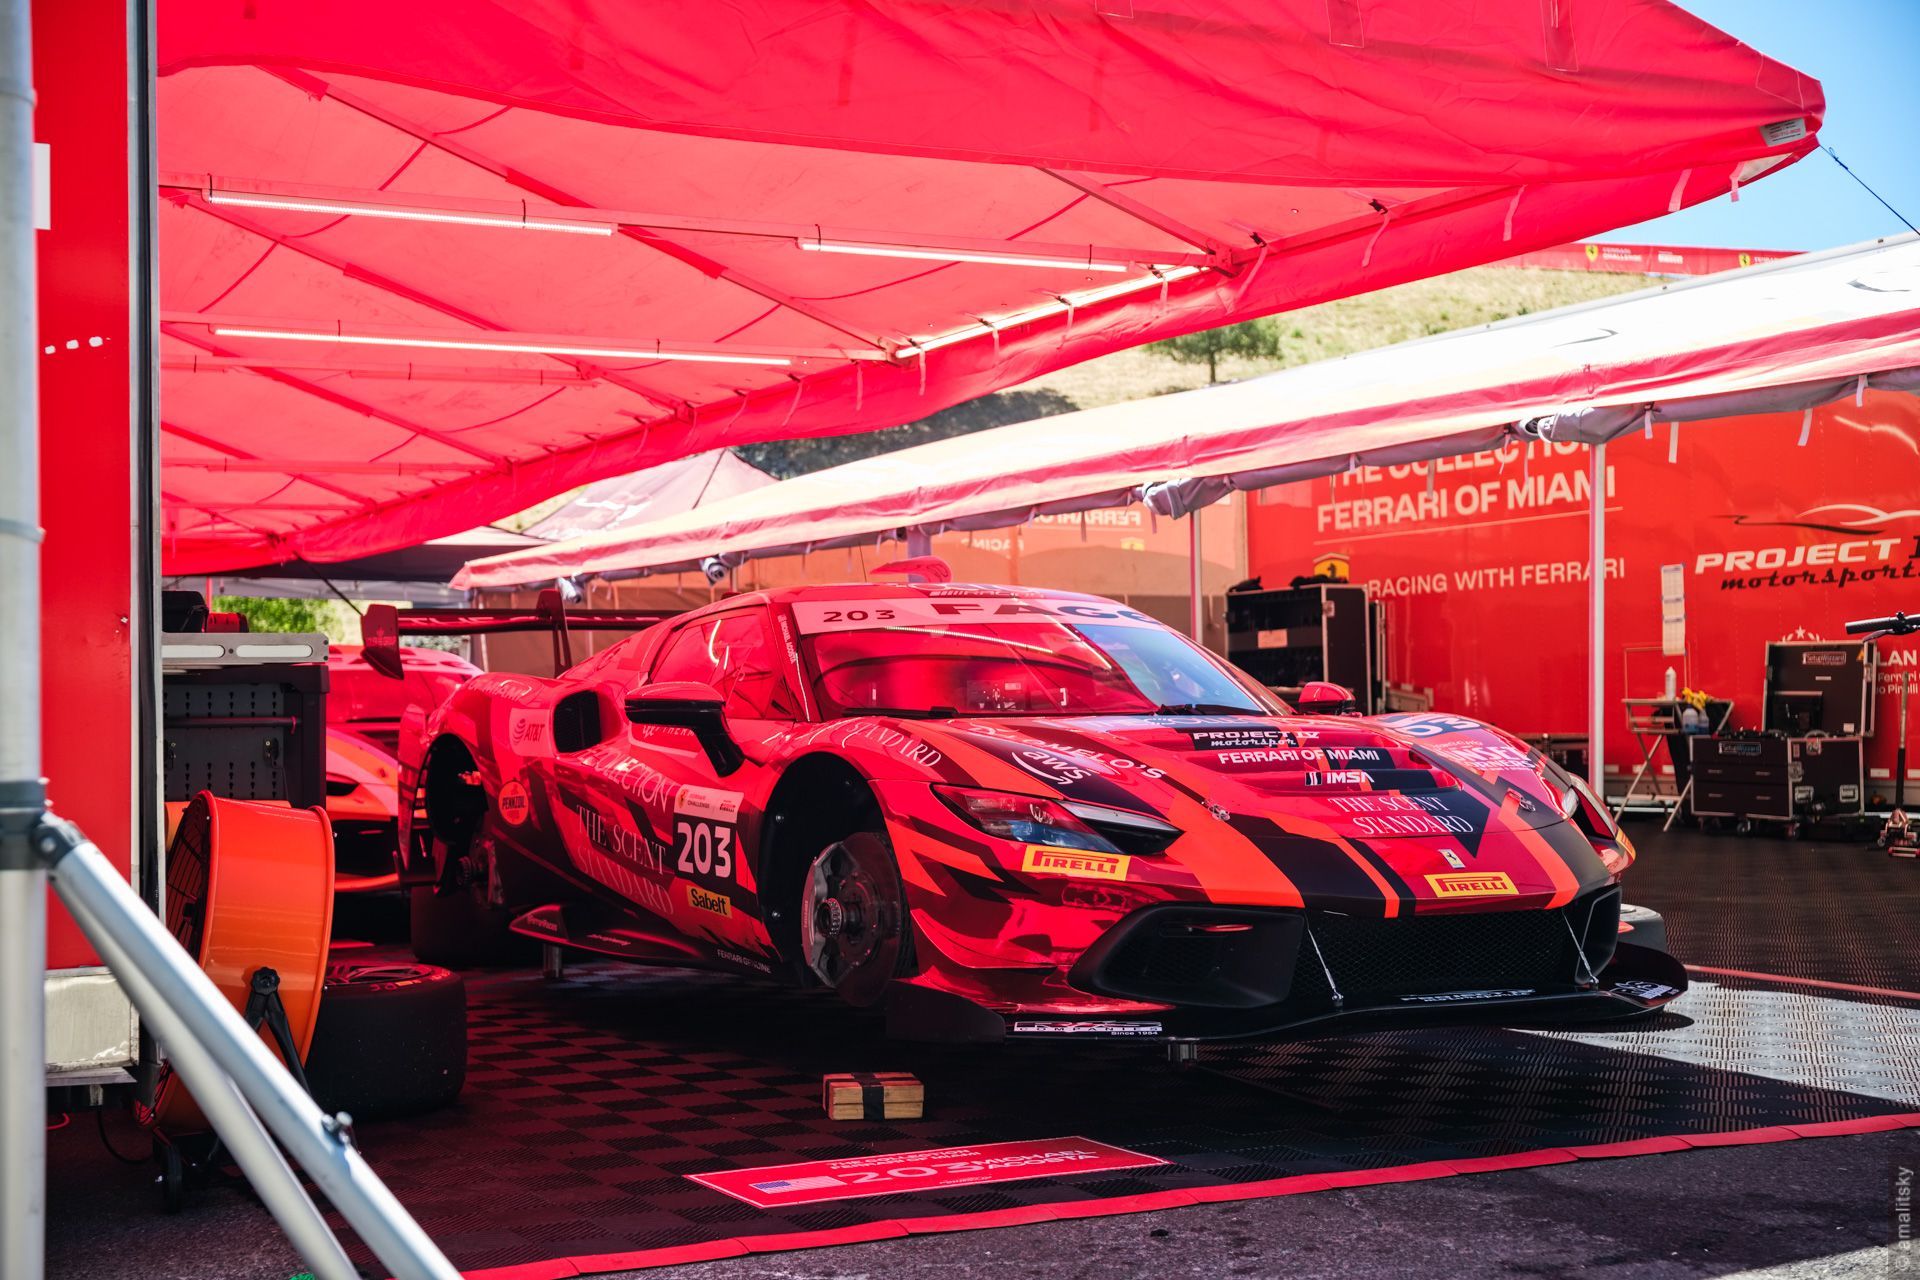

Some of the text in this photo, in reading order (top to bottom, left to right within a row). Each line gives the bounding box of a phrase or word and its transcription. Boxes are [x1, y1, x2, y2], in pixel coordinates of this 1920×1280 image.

[1388, 438, 1607, 479] COLLECTIO
[1317, 487, 1448, 533] FERRARI
[1454, 481, 1500, 516] OF
[1694, 538, 1902, 575] PROJECT
[1368, 572, 1448, 599] RACING
[1453, 564, 1515, 592] WITH
[1721, 560, 1920, 591] motorsport
[823, 610, 896, 623] 203
[1877, 671, 1917, 682] Ferrri
[1887, 683, 1918, 694] Pirlli
[524, 723, 546, 742] AT&T
[1193, 731, 1321, 740] PROJECT IV
[846, 722, 942, 767] STANDARD
[1022, 751, 1092, 780] aws
[1217, 750, 1380, 764] FERRARI OF MIAMI
[1327, 772, 1375, 784] IMSA
[1328, 796, 1451, 813] THE SCENT
[1352, 816, 1475, 835] STANDARD
[576, 804, 666, 876] THE SCENT
[676, 821, 732, 879] 203
[1031, 850, 1119, 874] PIRELLI
[577, 845, 674, 915] STANDARD
[1434, 876, 1508, 892] PIRELLI
[690, 888, 728, 916] Sabelt
[829, 1149, 971, 1168] THE COLLECTION
[830, 1158, 906, 1170] FERRARI
[931, 1151, 981, 1160] MIAMI
[971, 1150, 1097, 1166] MICHAEL
[987, 1154, 1100, 1170] ACOSTA
[838, 1162, 984, 1184] 203
